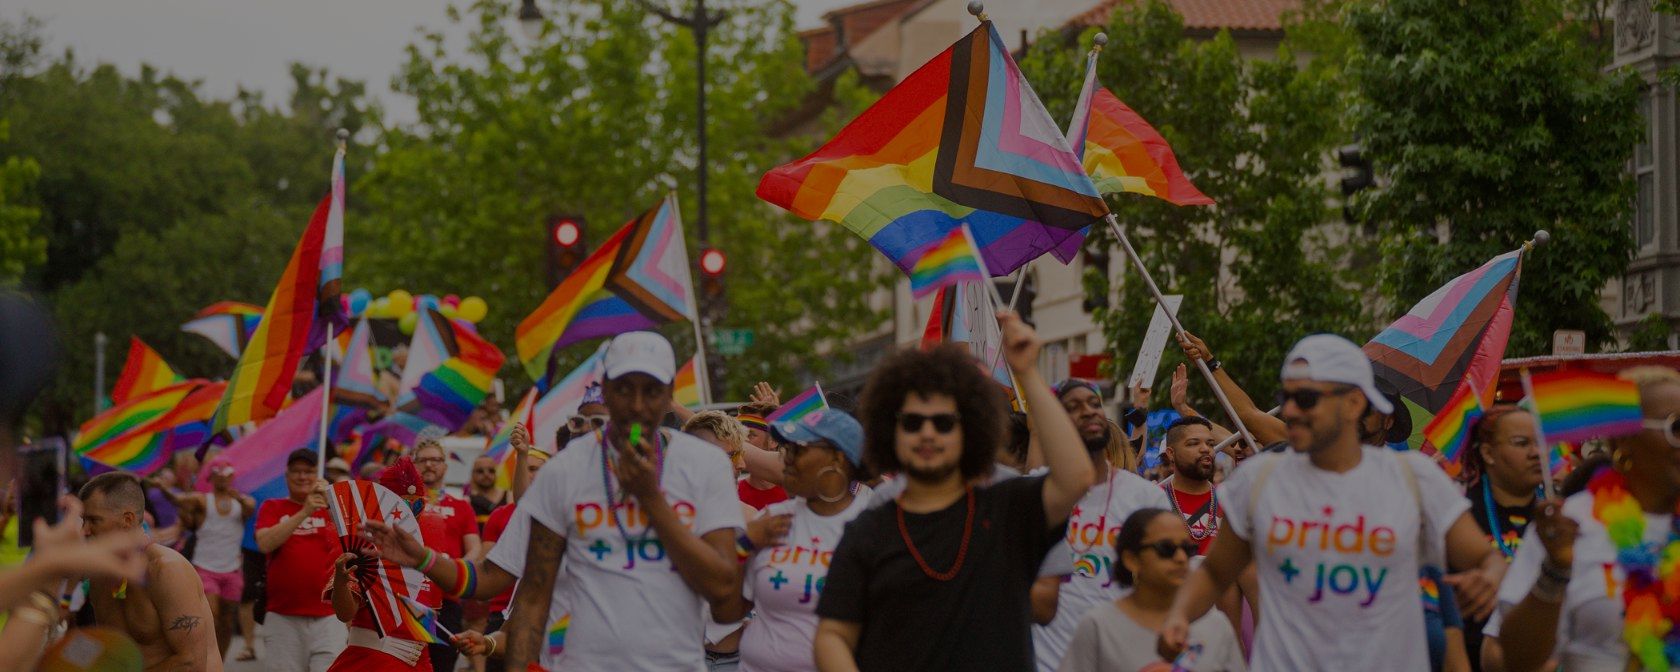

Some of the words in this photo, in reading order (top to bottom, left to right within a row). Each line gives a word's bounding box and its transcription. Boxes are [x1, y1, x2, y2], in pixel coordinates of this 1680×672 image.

[576, 501, 697, 537] prie
[1268, 505, 1396, 557] pride
[589, 540, 611, 560] +
[623, 538, 678, 571] jo
[769, 571, 788, 590] +
[1279, 557, 1299, 583] +
[1309, 564, 1386, 607] joy
